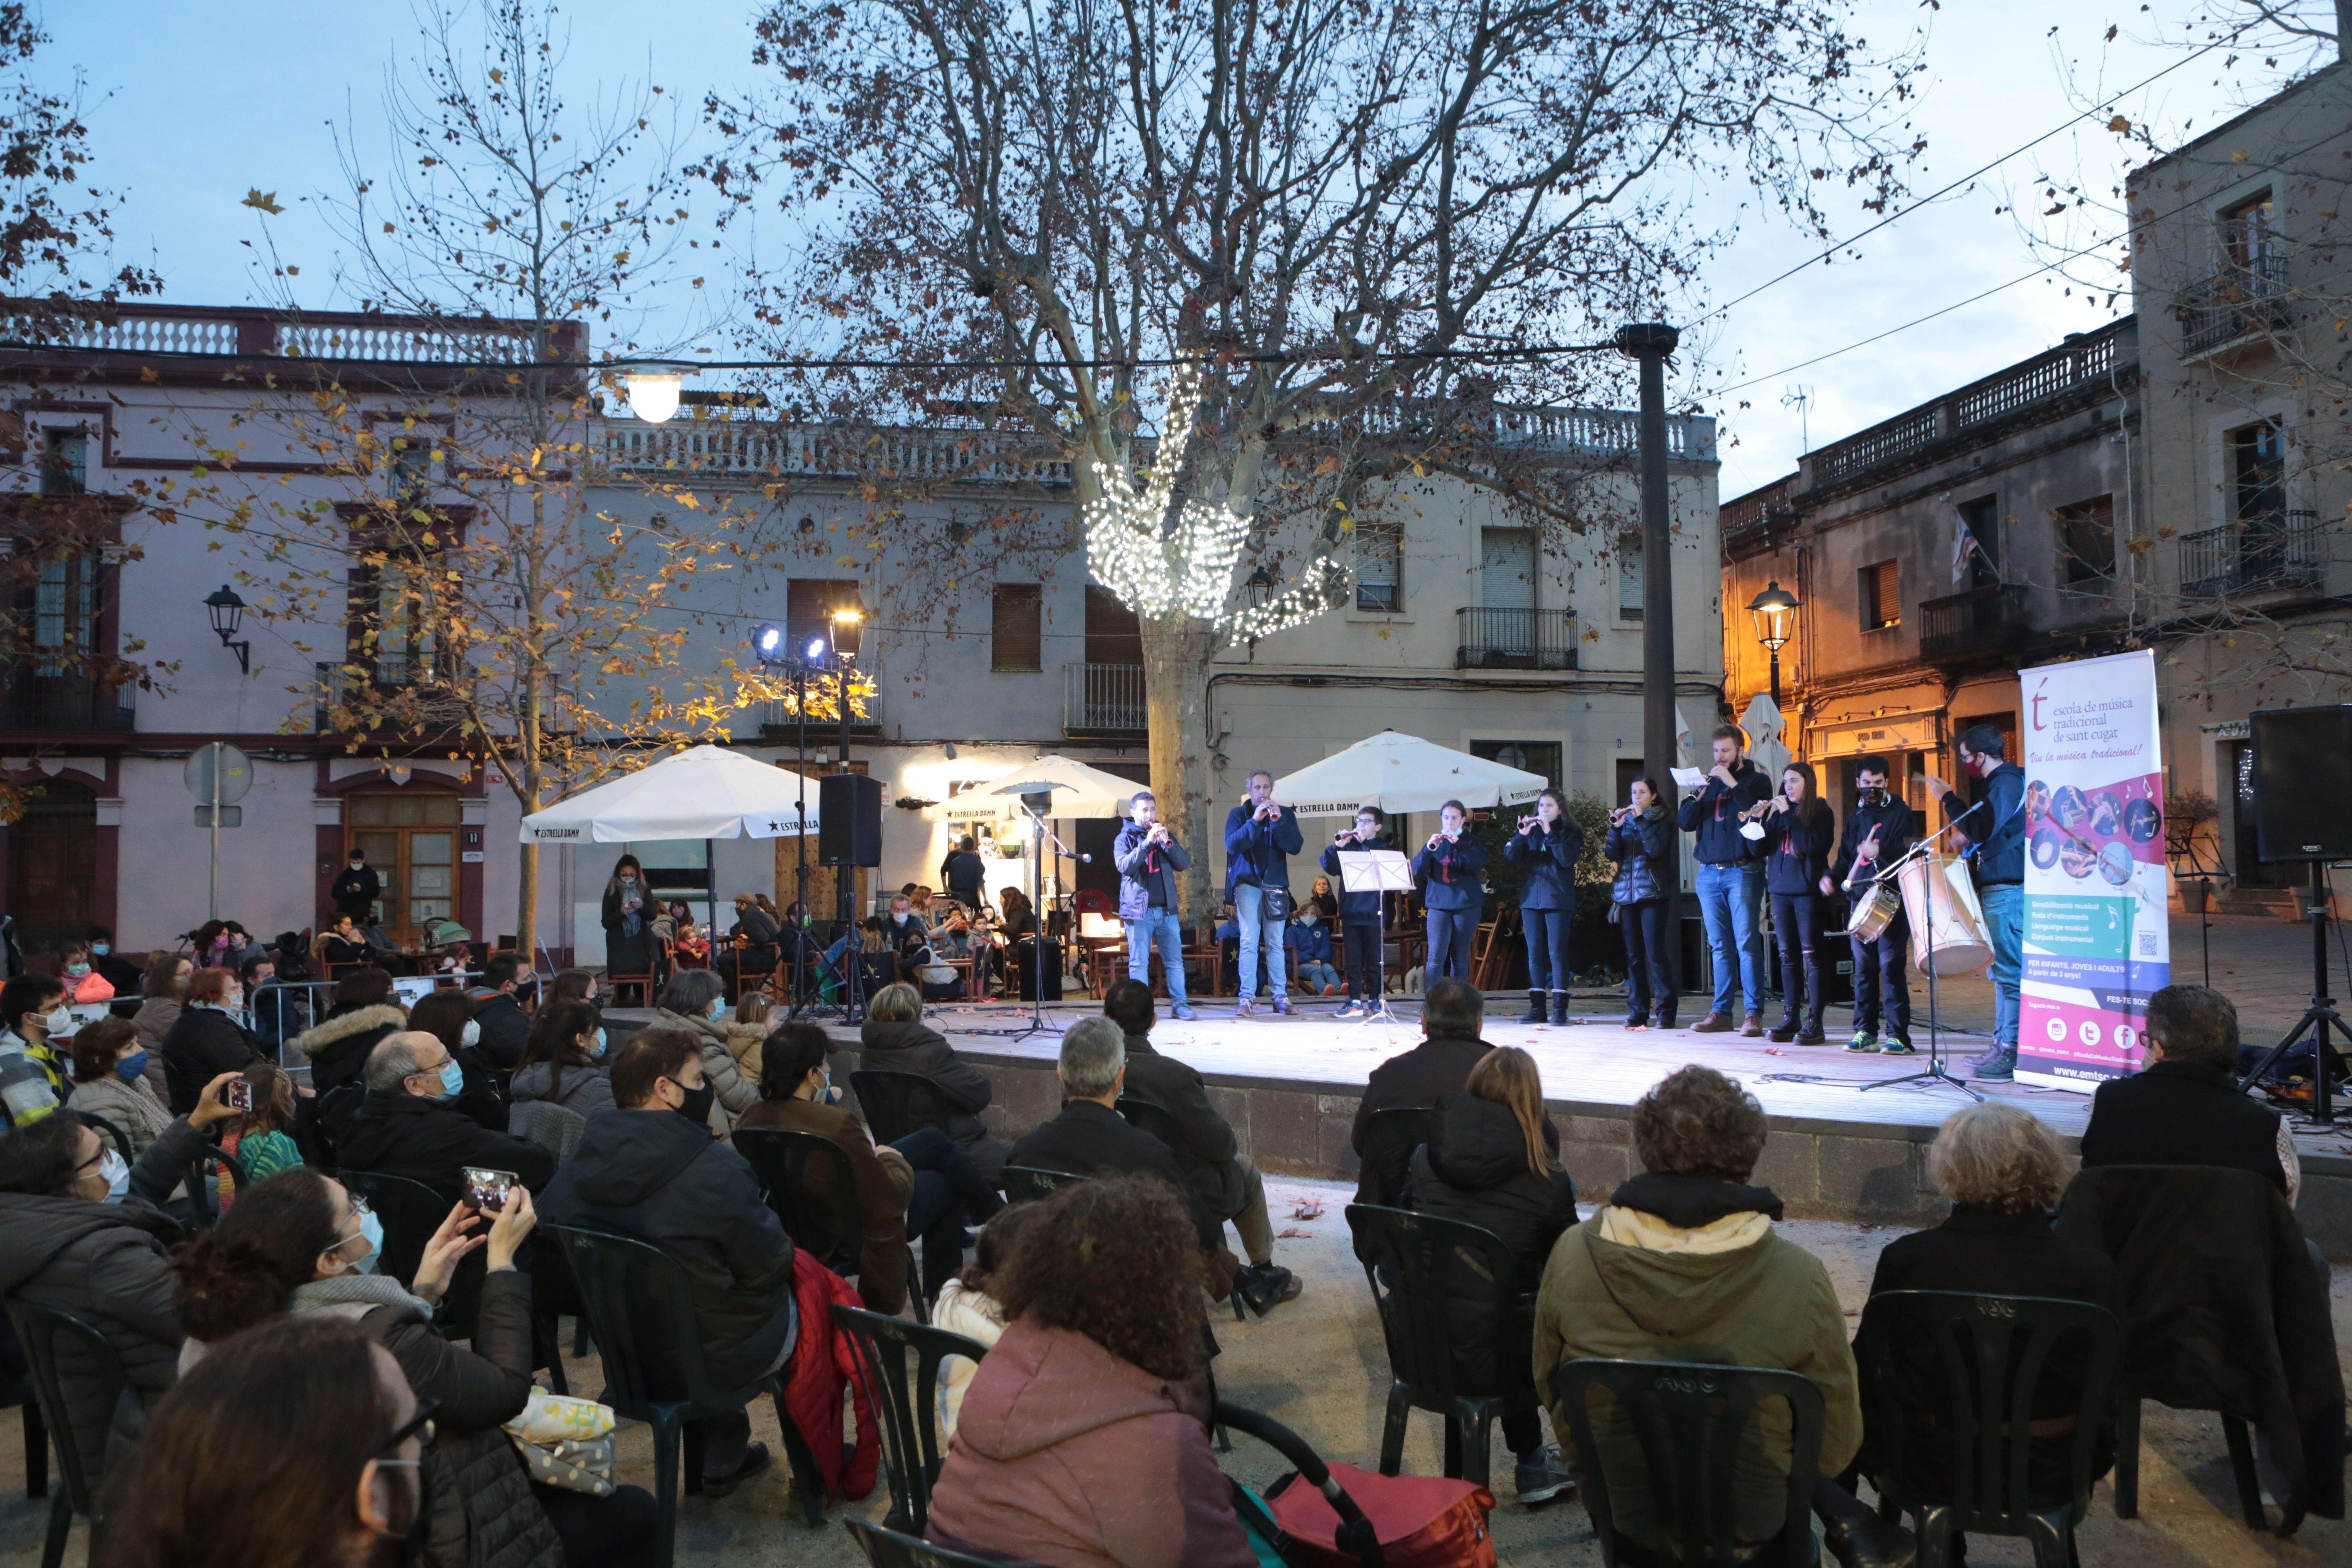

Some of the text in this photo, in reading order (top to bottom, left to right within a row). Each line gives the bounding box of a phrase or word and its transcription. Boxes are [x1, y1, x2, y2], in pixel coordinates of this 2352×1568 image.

[2054, 697, 2133, 716] escola de música
[2054, 713, 2107, 729] tradicional
[2054, 728, 2118, 743] de sant cugat
[2030, 744, 2143, 764] Viu la música tradicional!
[1300, 803, 1359, 813] ESTRELLA DAMM
[780, 820, 820, 831] ESTRLLA
[541, 829, 579, 837] ESTRELLA DAMM
[2031, 933, 2094, 943] Conjunt instrumental
[2071, 962, 2093, 971] JOVES
[2033, 969, 2049, 977] partir
[2107, 995, 2131, 1005] FES-TE
